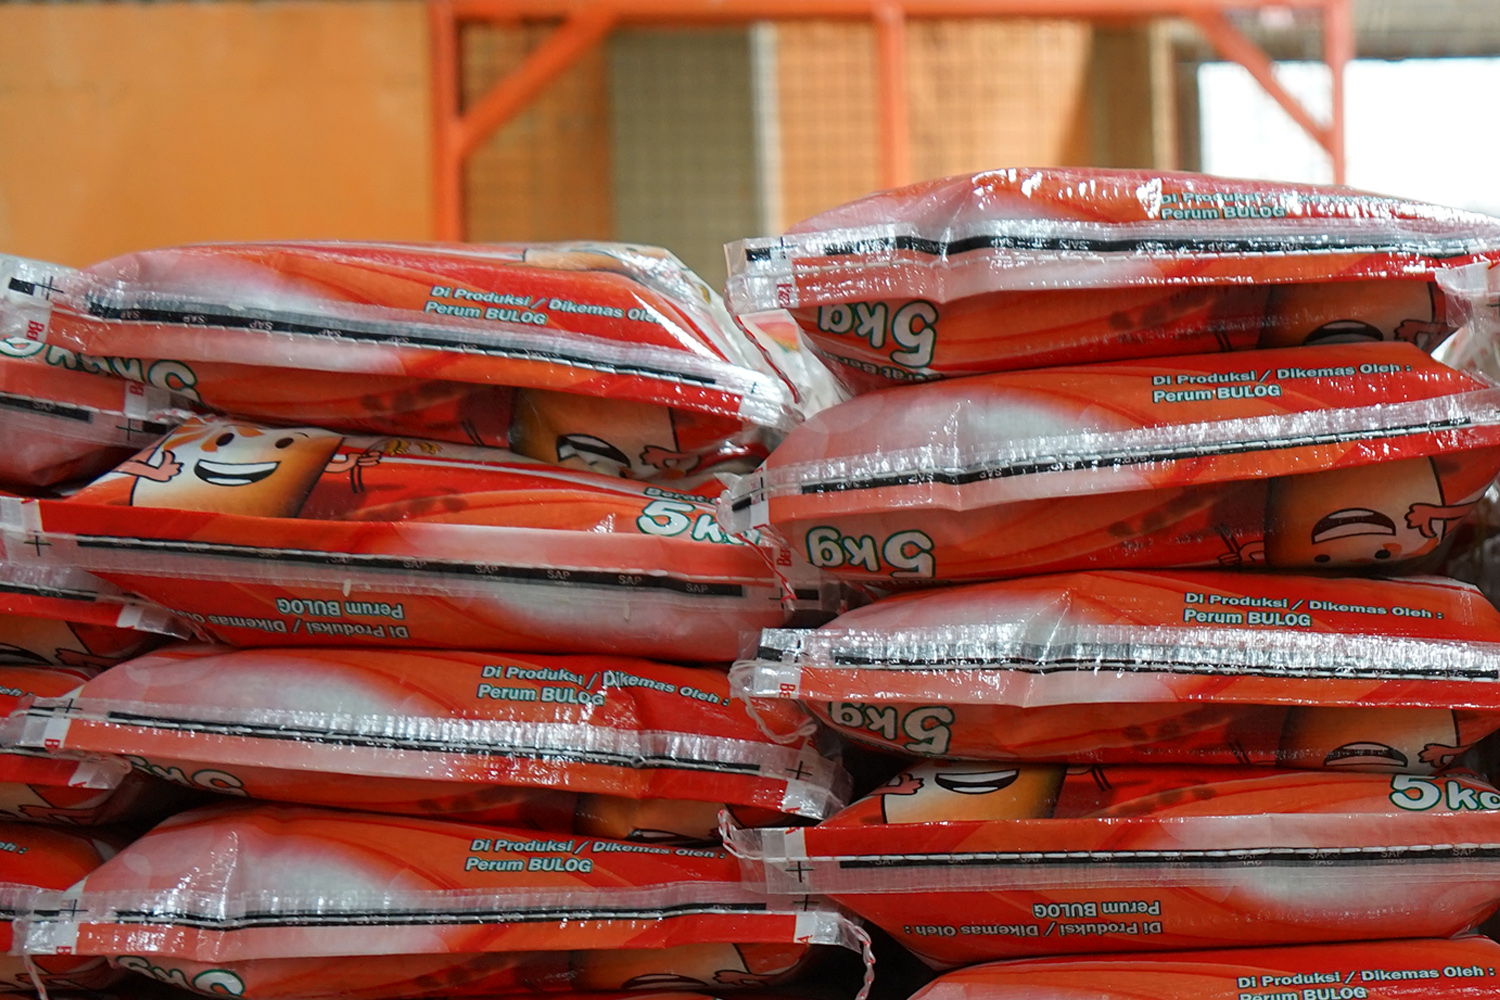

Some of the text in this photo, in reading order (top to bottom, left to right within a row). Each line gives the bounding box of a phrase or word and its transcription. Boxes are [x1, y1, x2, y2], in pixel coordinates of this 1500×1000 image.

[425, 302, 548, 324] Perum BULOG
[1153, 384, 1282, 402] Perum BULOG
[806, 526, 936, 579] 5kg
[277, 598, 404, 619] Perum BULOG
[1185, 593, 1204, 604] Di
[1208, 594, 1289, 609] Produksi
[1308, 600, 1387, 615] Dikemas
[1391, 607, 1433, 619] Oleh
[1184, 609, 1312, 627] Perum BULOG
[477, 684, 605, 705] Perum BULOG
[482, 665, 502, 678] Di
[506, 666, 583, 685] Produksi
[602, 670, 675, 694] Dikemas
[680, 686, 719, 704] Oleh
[470, 839, 491, 852] Di
[495, 839, 574, 853] Produksi
[593, 842, 670, 854] Dikemas
[465, 857, 593, 873] Perum BULOG
[1032, 902, 1161, 919] Perum BULOG
[1238, 976, 1256, 988] Di
[1260, 971, 1341, 986] Produksi
[1360, 967, 1440, 981] Dikemas
[1444, 965, 1485, 978] Oleh
